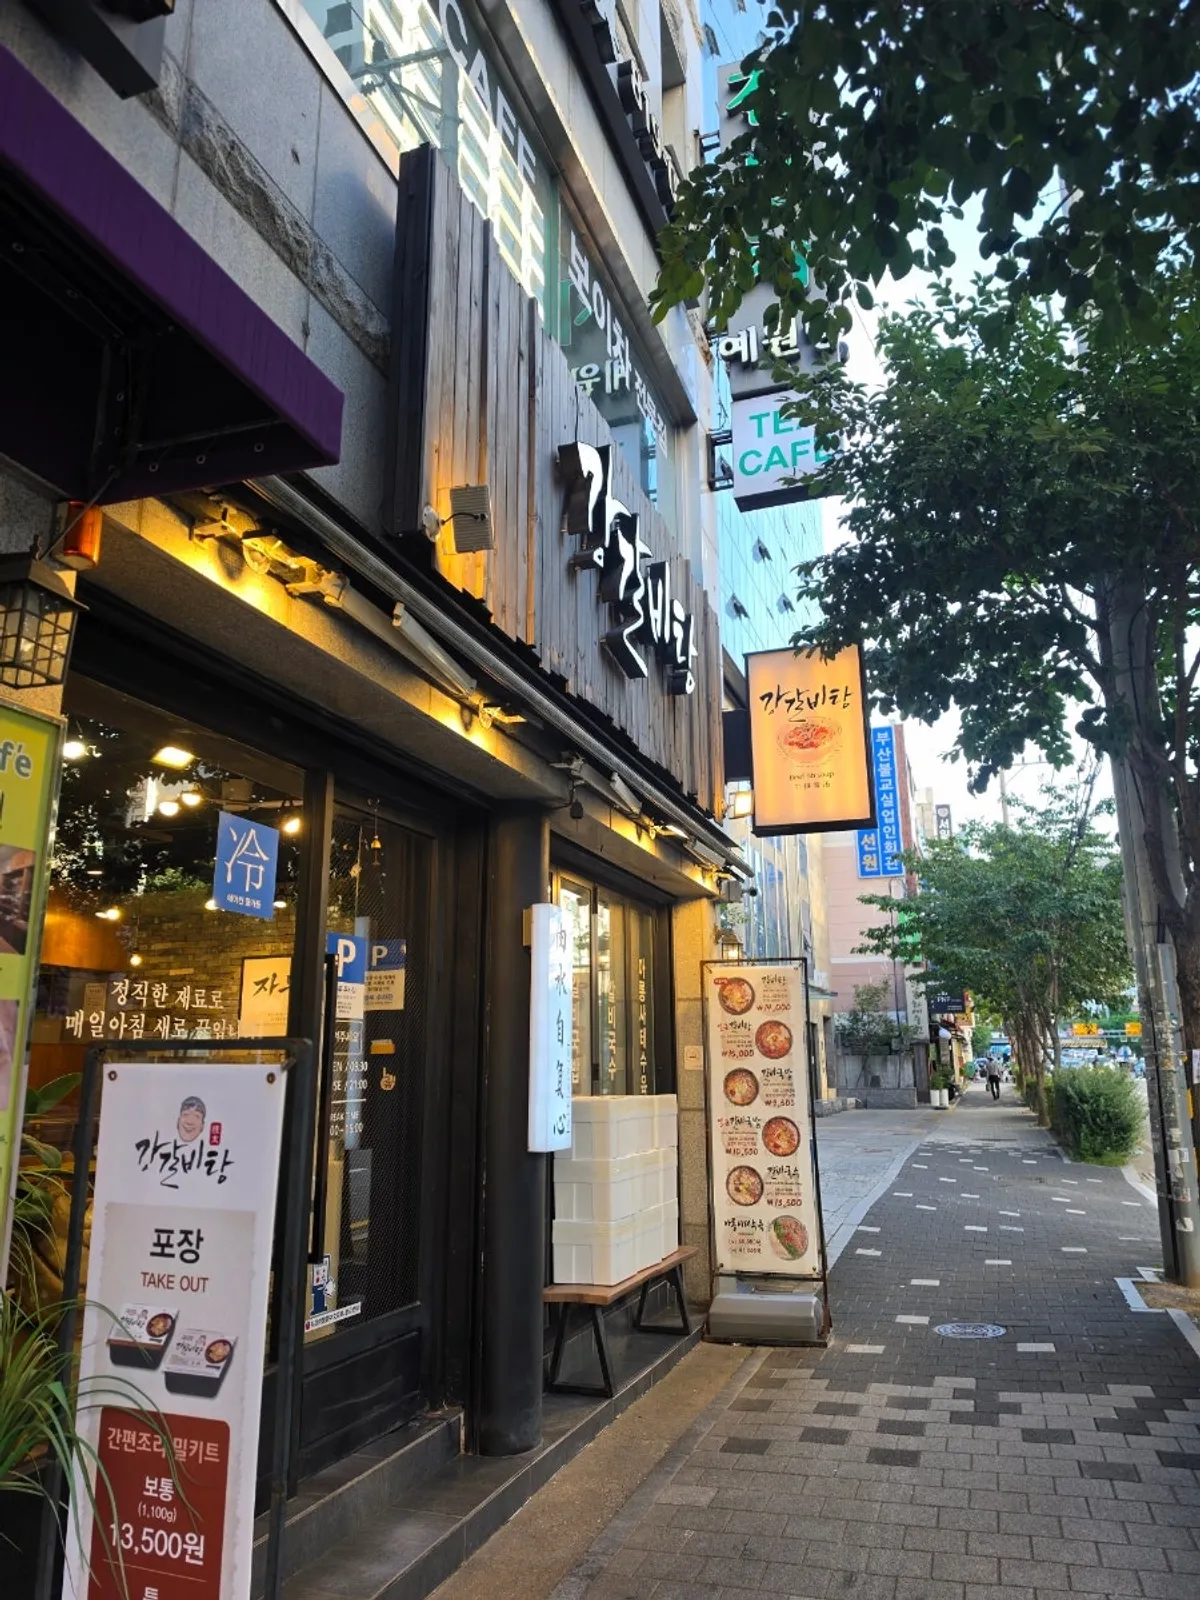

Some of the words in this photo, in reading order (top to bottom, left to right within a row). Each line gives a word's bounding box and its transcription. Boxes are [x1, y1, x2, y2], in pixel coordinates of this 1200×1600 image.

[439, 0, 536, 184] CAFE
[576, 441, 698, 694] 강갈비탕
[759, 684, 854, 722] 강갈비탕
[225, 826, 269, 893] 冷
[337, 938, 356, 978] P
[372, 945, 388, 967] P
[111, 979, 169, 1006] 정직한
[174, 986, 224, 1010] 재료로
[65, 1009, 147, 1040] 매일아침
[153, 1014, 188, 1040] 새로
[135, 1130, 235, 1189] 강갈비탕
[150, 1228, 204, 1264] 포장
[140, 1271, 175, 1291] TAKE
[179, 1274, 209, 1293] OUT
[107, 1427, 168, 1459] 간편조리
[173, 1437, 221, 1464] 밀키트
[142, 1475, 175, 1502] 보통
[137, 1503, 177, 1523] (1,100g)
[109, 1522, 204, 1566] 13,500원
